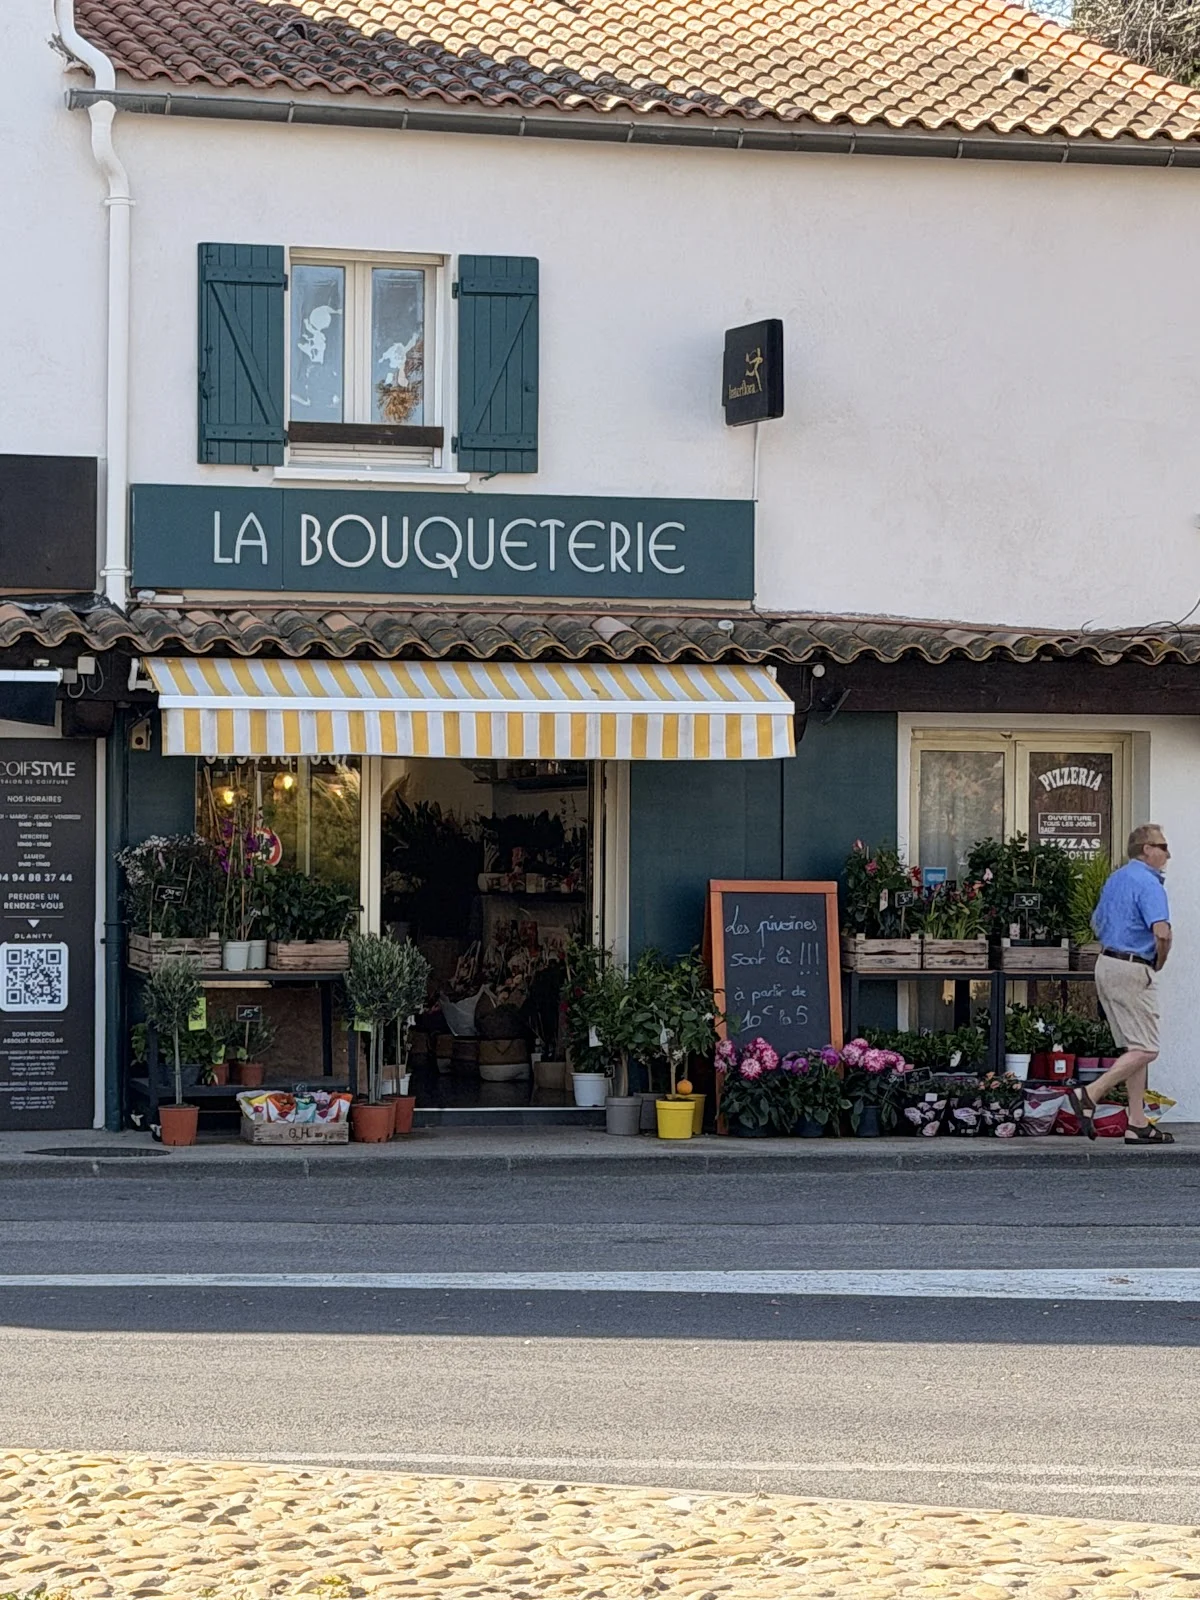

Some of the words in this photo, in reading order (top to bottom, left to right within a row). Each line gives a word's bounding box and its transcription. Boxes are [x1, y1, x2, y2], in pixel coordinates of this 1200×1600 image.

[214, 511, 268, 565] LA
[301, 513, 685, 579] BOUQUETERIE
[1038, 766, 1103, 792] PIZZERIA
[7, 795, 24, 803] NOS
[26, 795, 62, 803] HORAIRES
[0, 873, 9, 882] 4
[12, 873, 25, 882] 94
[28, 873, 41, 882] 88
[44, 873, 57, 882] 37
[59, 873, 73, 882] 44
[8, 892, 45, 901] PRENDRE
[47, 892, 60, 901] UN
[3, 902, 64, 910] RENDEZ-VOUS
[725, 905, 750, 935] Les
[734, 986, 745, 1001] à
[751, 983, 787, 1006] partir
[791, 985, 807, 998] de
